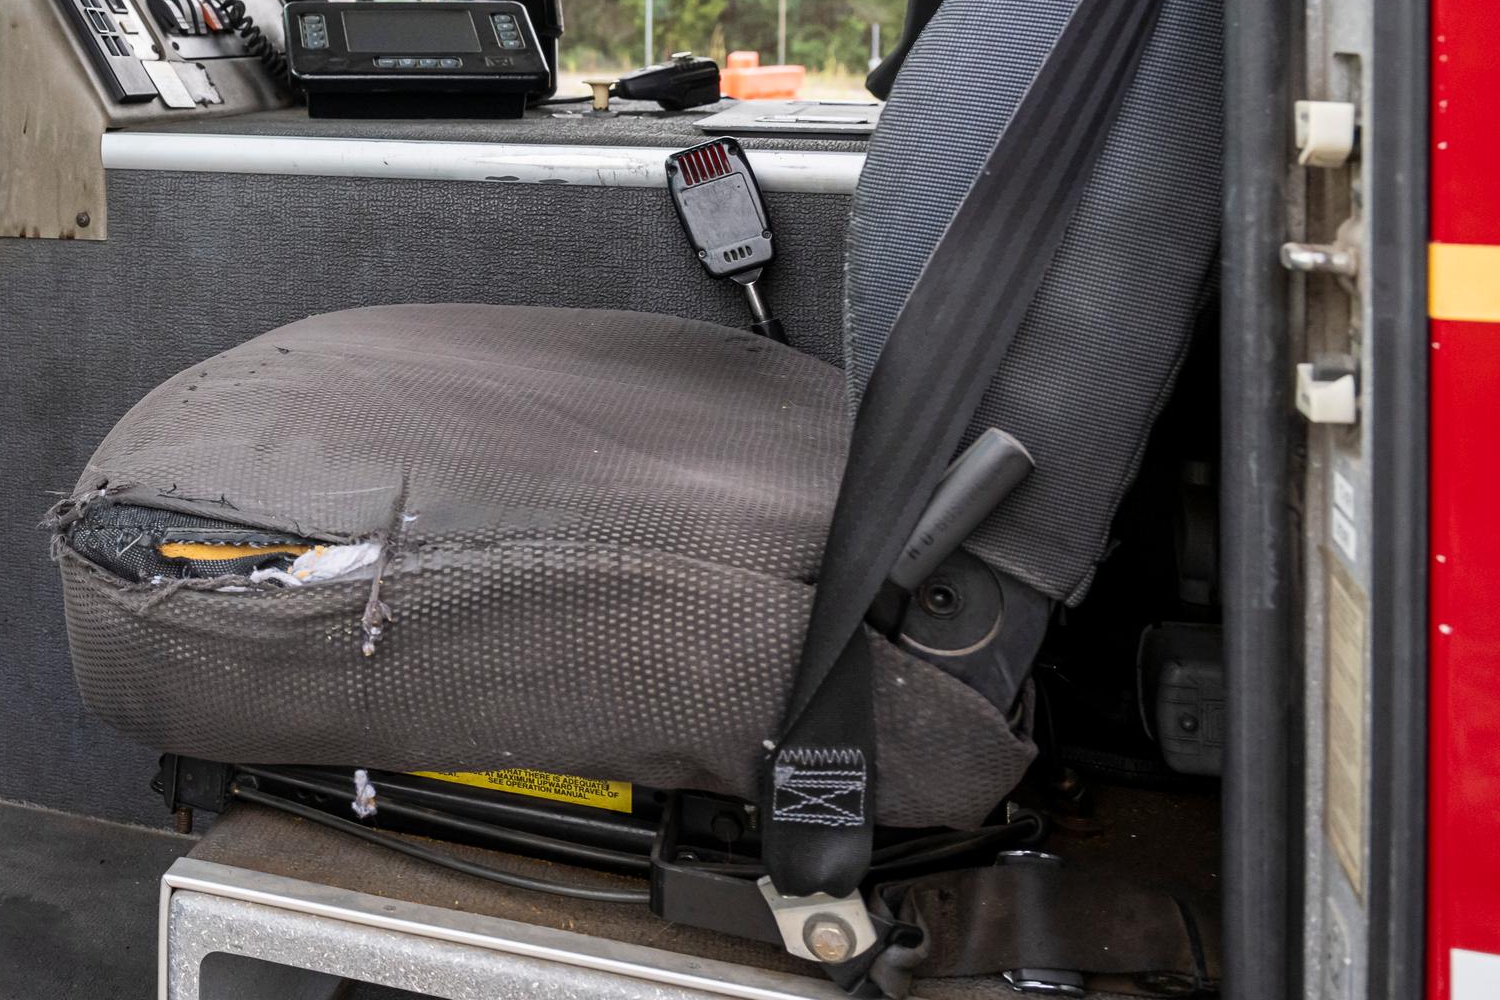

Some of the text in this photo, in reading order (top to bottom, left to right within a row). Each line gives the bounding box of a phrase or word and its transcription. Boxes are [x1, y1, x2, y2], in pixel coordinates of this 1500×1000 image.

[496, 772, 535, 784] MAXIMUM
[537, 780, 572, 791] UPWARD
[574, 786, 606, 797] TRAVEL
[525, 770, 550, 780] THERE
[488, 776, 504, 786] SEE
[506, 780, 552, 793] OPERATION
[554, 788, 590, 800] MANUAL.
